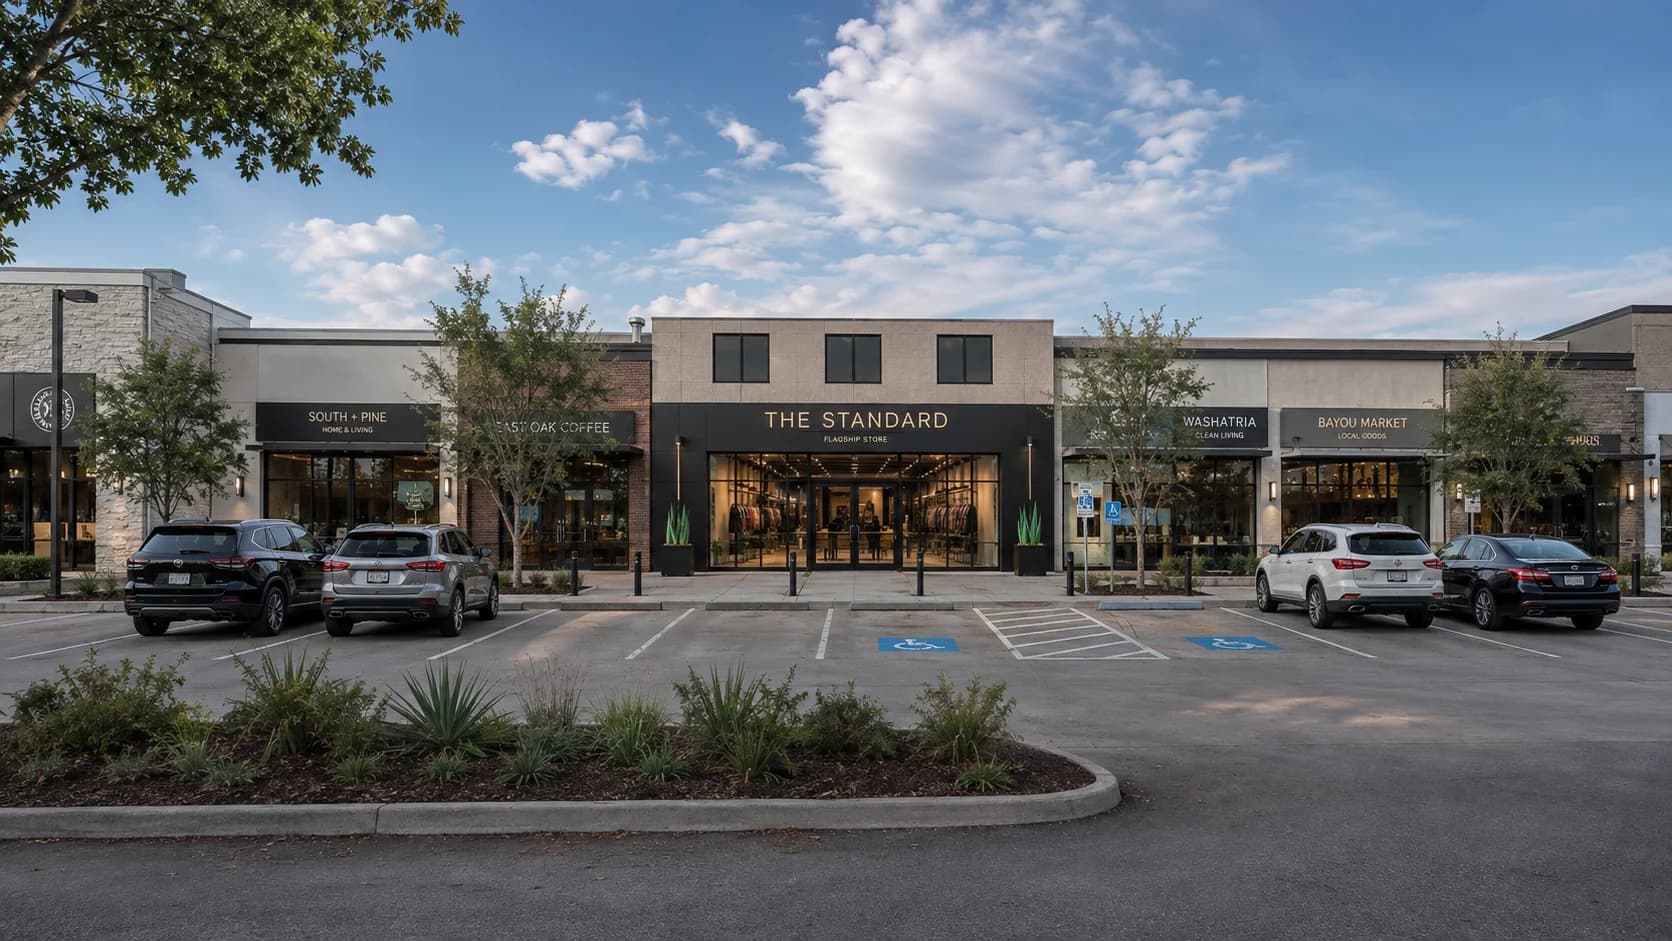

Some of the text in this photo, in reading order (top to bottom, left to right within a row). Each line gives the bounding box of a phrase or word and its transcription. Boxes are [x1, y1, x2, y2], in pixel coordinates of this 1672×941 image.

[308, 411, 348, 422] SOUTH
[361, 411, 388, 423] PINE
[764, 411, 948, 429] THE STANDARD
[1183, 416, 1257, 428] WASHATRIA
[1318, 417, 1408, 429] BAYOU MARKET
[350, 426, 374, 434] LIVING
[530, 421, 556, 433] OAK
[560, 421, 610, 433] COFFEE
[823, 435, 888, 443] FLAGSHIP STORE
[1194, 431, 1244, 440] CLEAN LIVING
[1337, 432, 1387, 440] LOCAL GOODS
